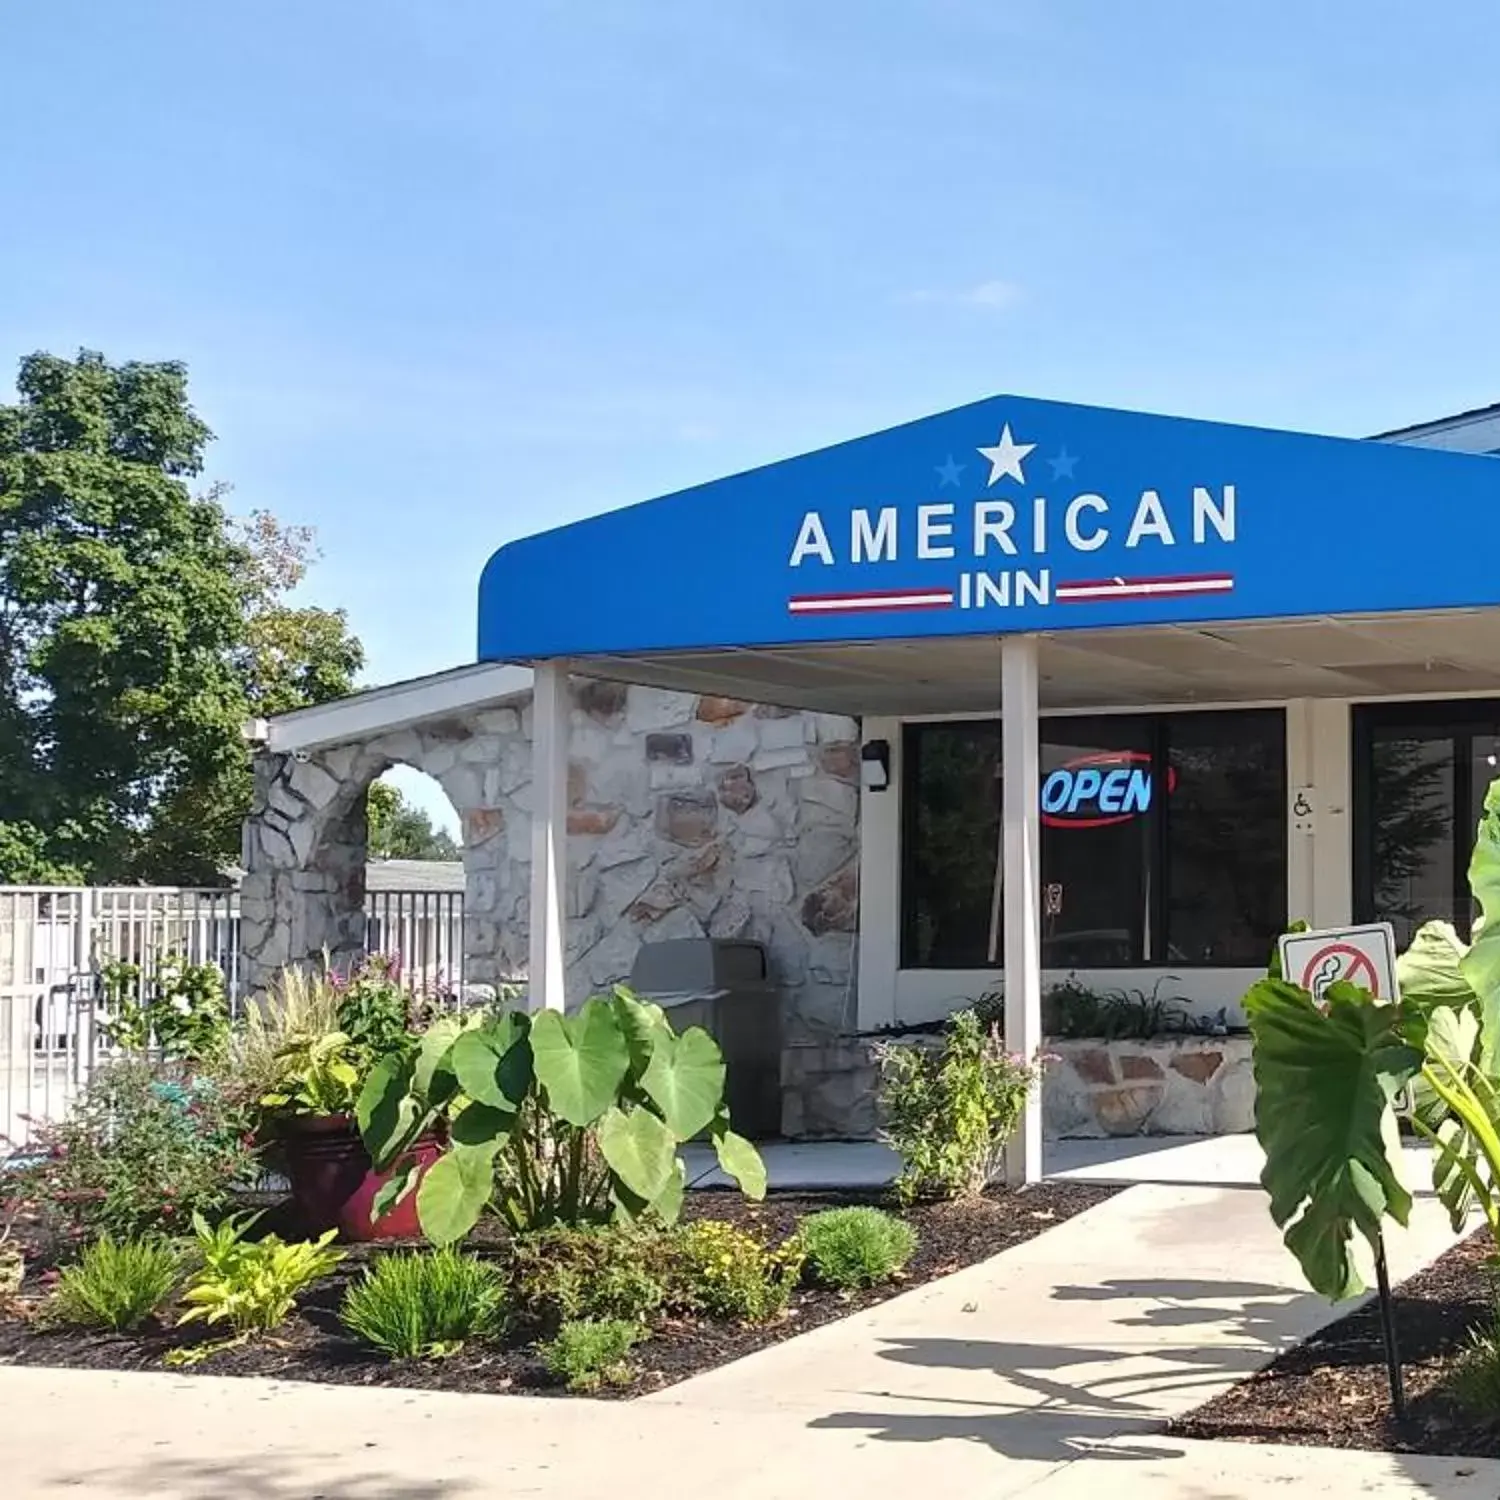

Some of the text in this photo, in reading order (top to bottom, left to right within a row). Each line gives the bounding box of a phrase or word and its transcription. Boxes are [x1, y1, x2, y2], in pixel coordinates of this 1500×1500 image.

[789, 486, 1236, 566] AMERICAN
[960, 570, 1050, 608] INN
[1042, 769, 1152, 812] OPEN
